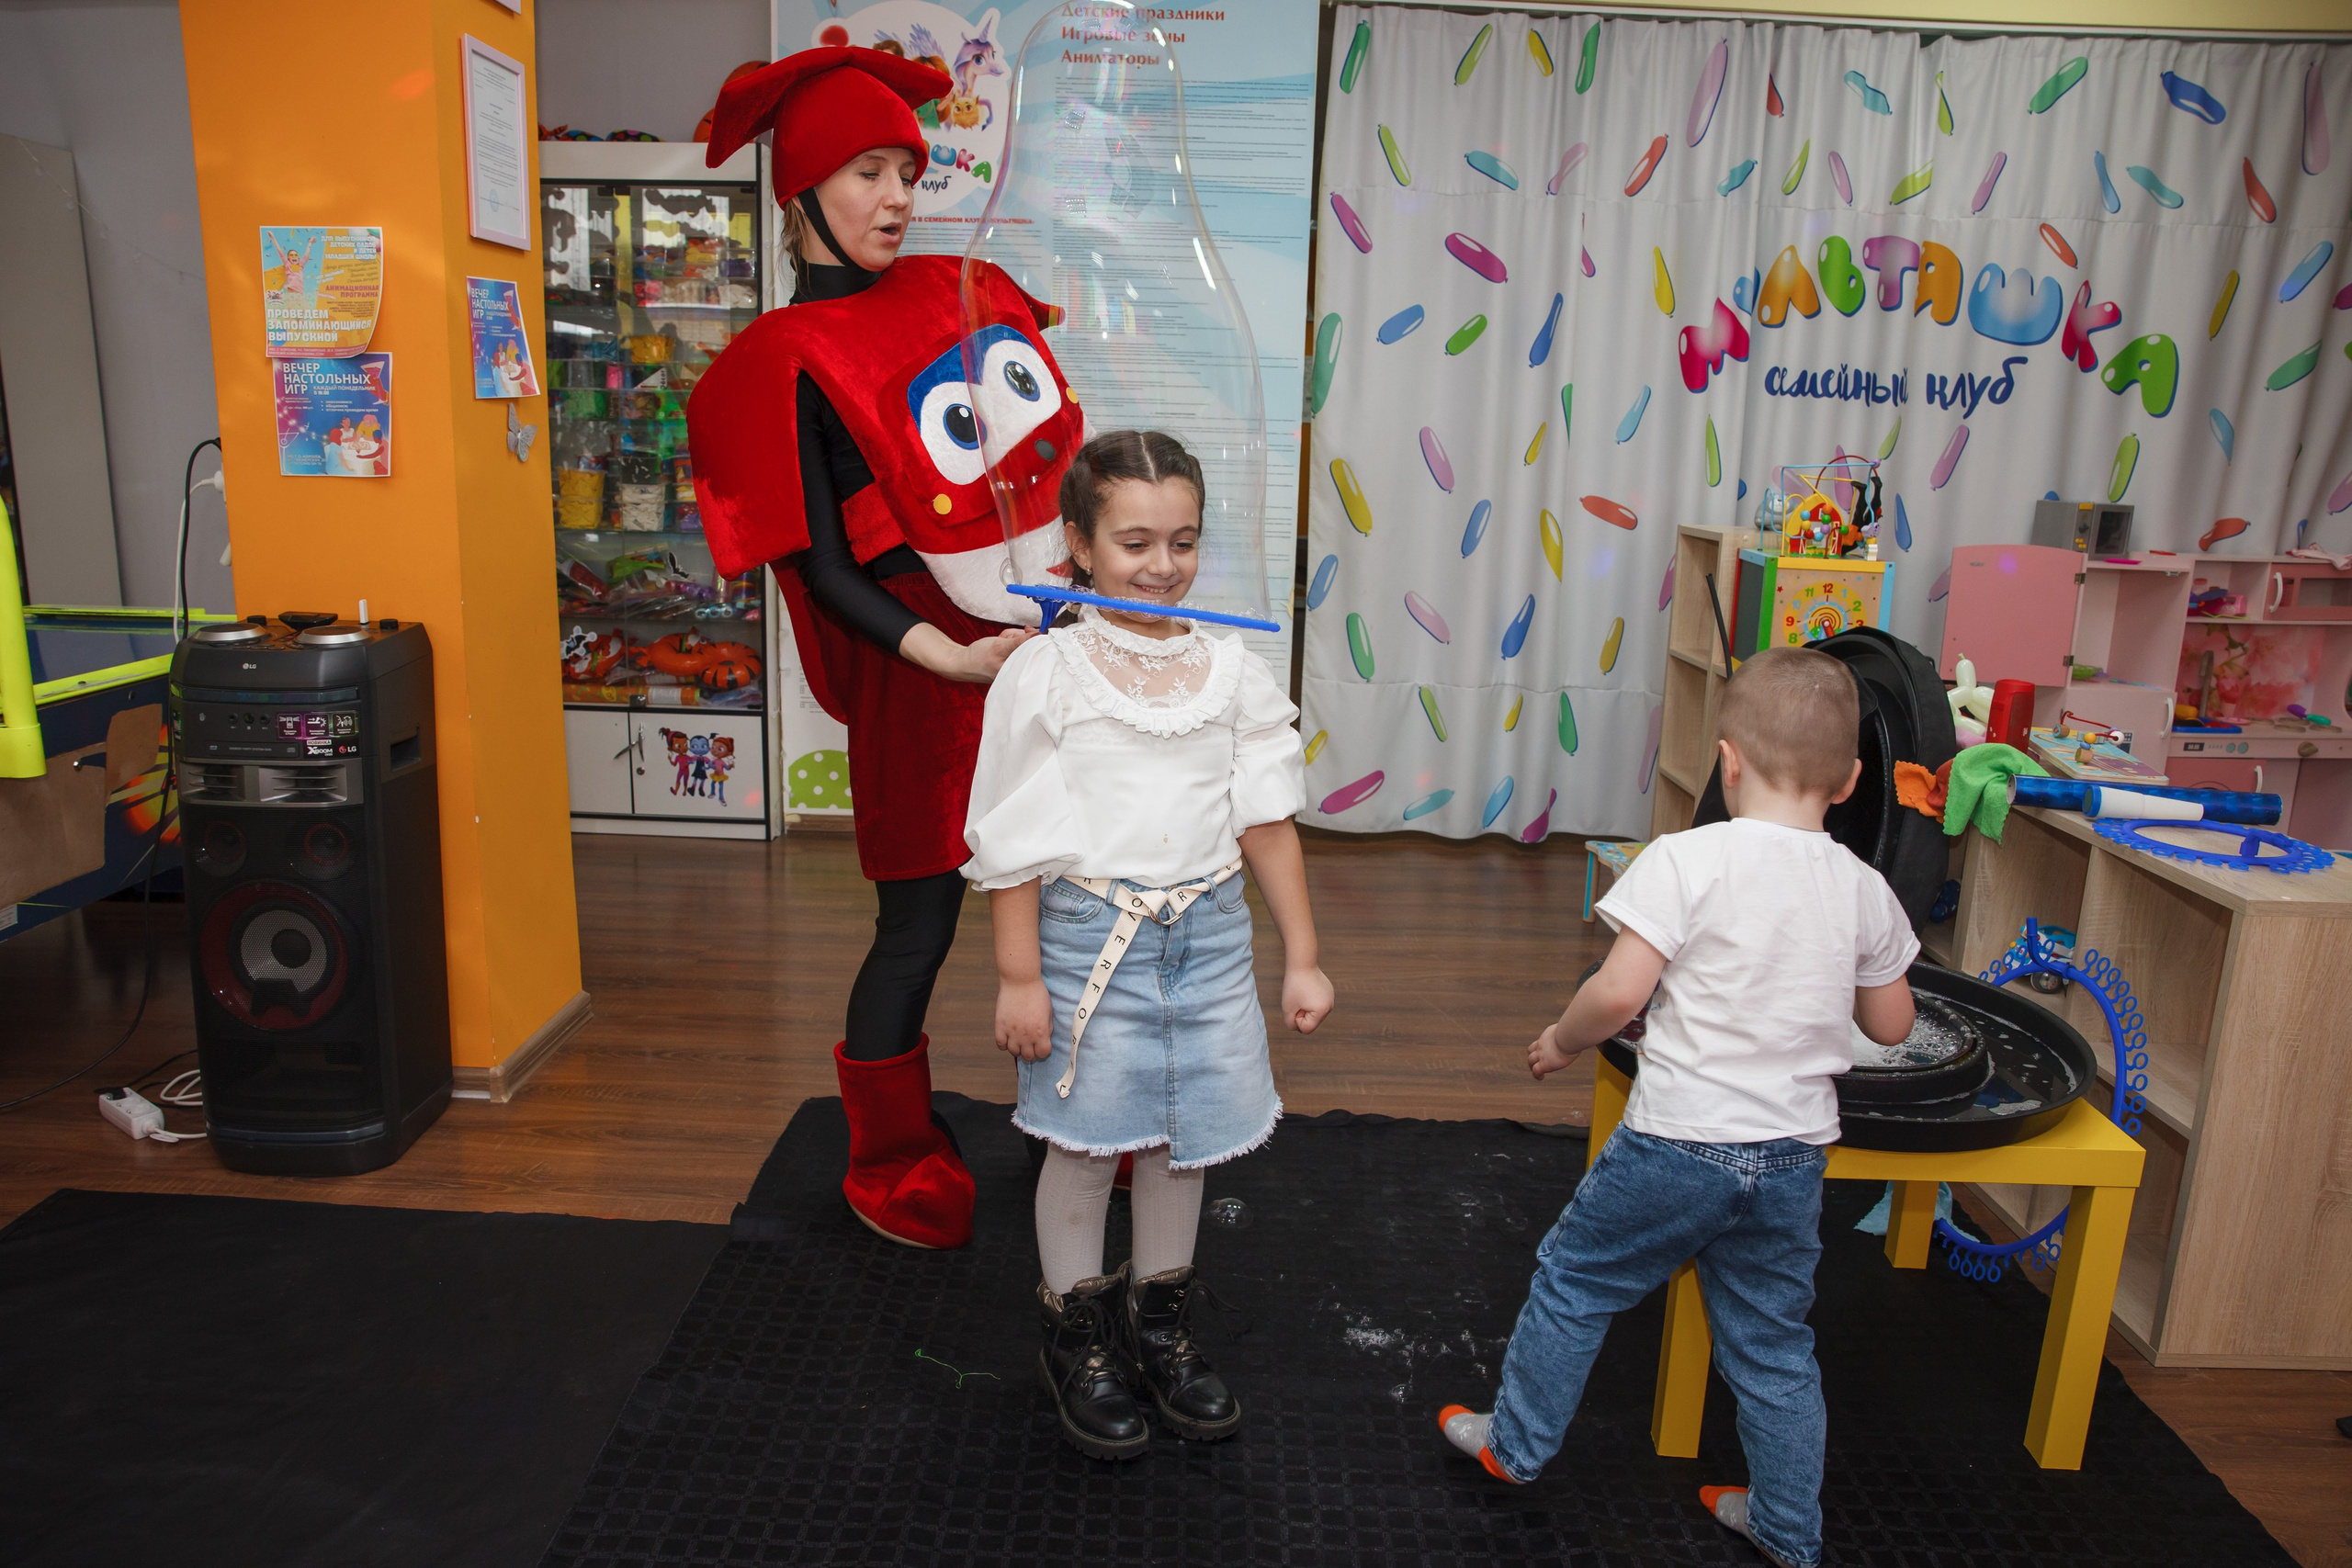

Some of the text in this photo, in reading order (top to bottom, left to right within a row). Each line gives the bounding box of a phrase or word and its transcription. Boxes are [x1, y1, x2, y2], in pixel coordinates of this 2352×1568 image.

[1061, 5, 1225, 24] Детские праздники
[1061, 26, 1136, 44] Игровые
[1060, 50, 1160, 69] Аниматоры
[922, 175, 952, 195] клуб
[924, 215, 963, 223] СЕМЕЙНОМ
[471, 288, 490, 299] ВЕЧЕР
[471, 299, 509, 311] НАСТОЛЬНЫХ
[267, 309, 329, 320] ПРОВЕДЕМ
[472, 310, 484, 319] ИГР
[267, 319, 371, 331] ЗАПОМИНАЮЩИЙСЯ
[268, 331, 338, 342] ВЫПУСКНОЙ
[283, 362, 321, 374] ВЕЧЕР
[283, 373, 372, 384] НАСТОЛЬНЫХ
[285, 384, 308, 395] ИГР
[1927, 359, 2029, 419] клуб
[1805, 588, 1814, 597] 11
[1823, 583, 1833, 593] 12
[1840, 588, 1847, 597] 1
[1792, 600, 1802, 609] 10
[1852, 601, 1862, 612] 2
[1786, 616, 1794, 626] 9
[1788, 633, 1798, 644] 8
